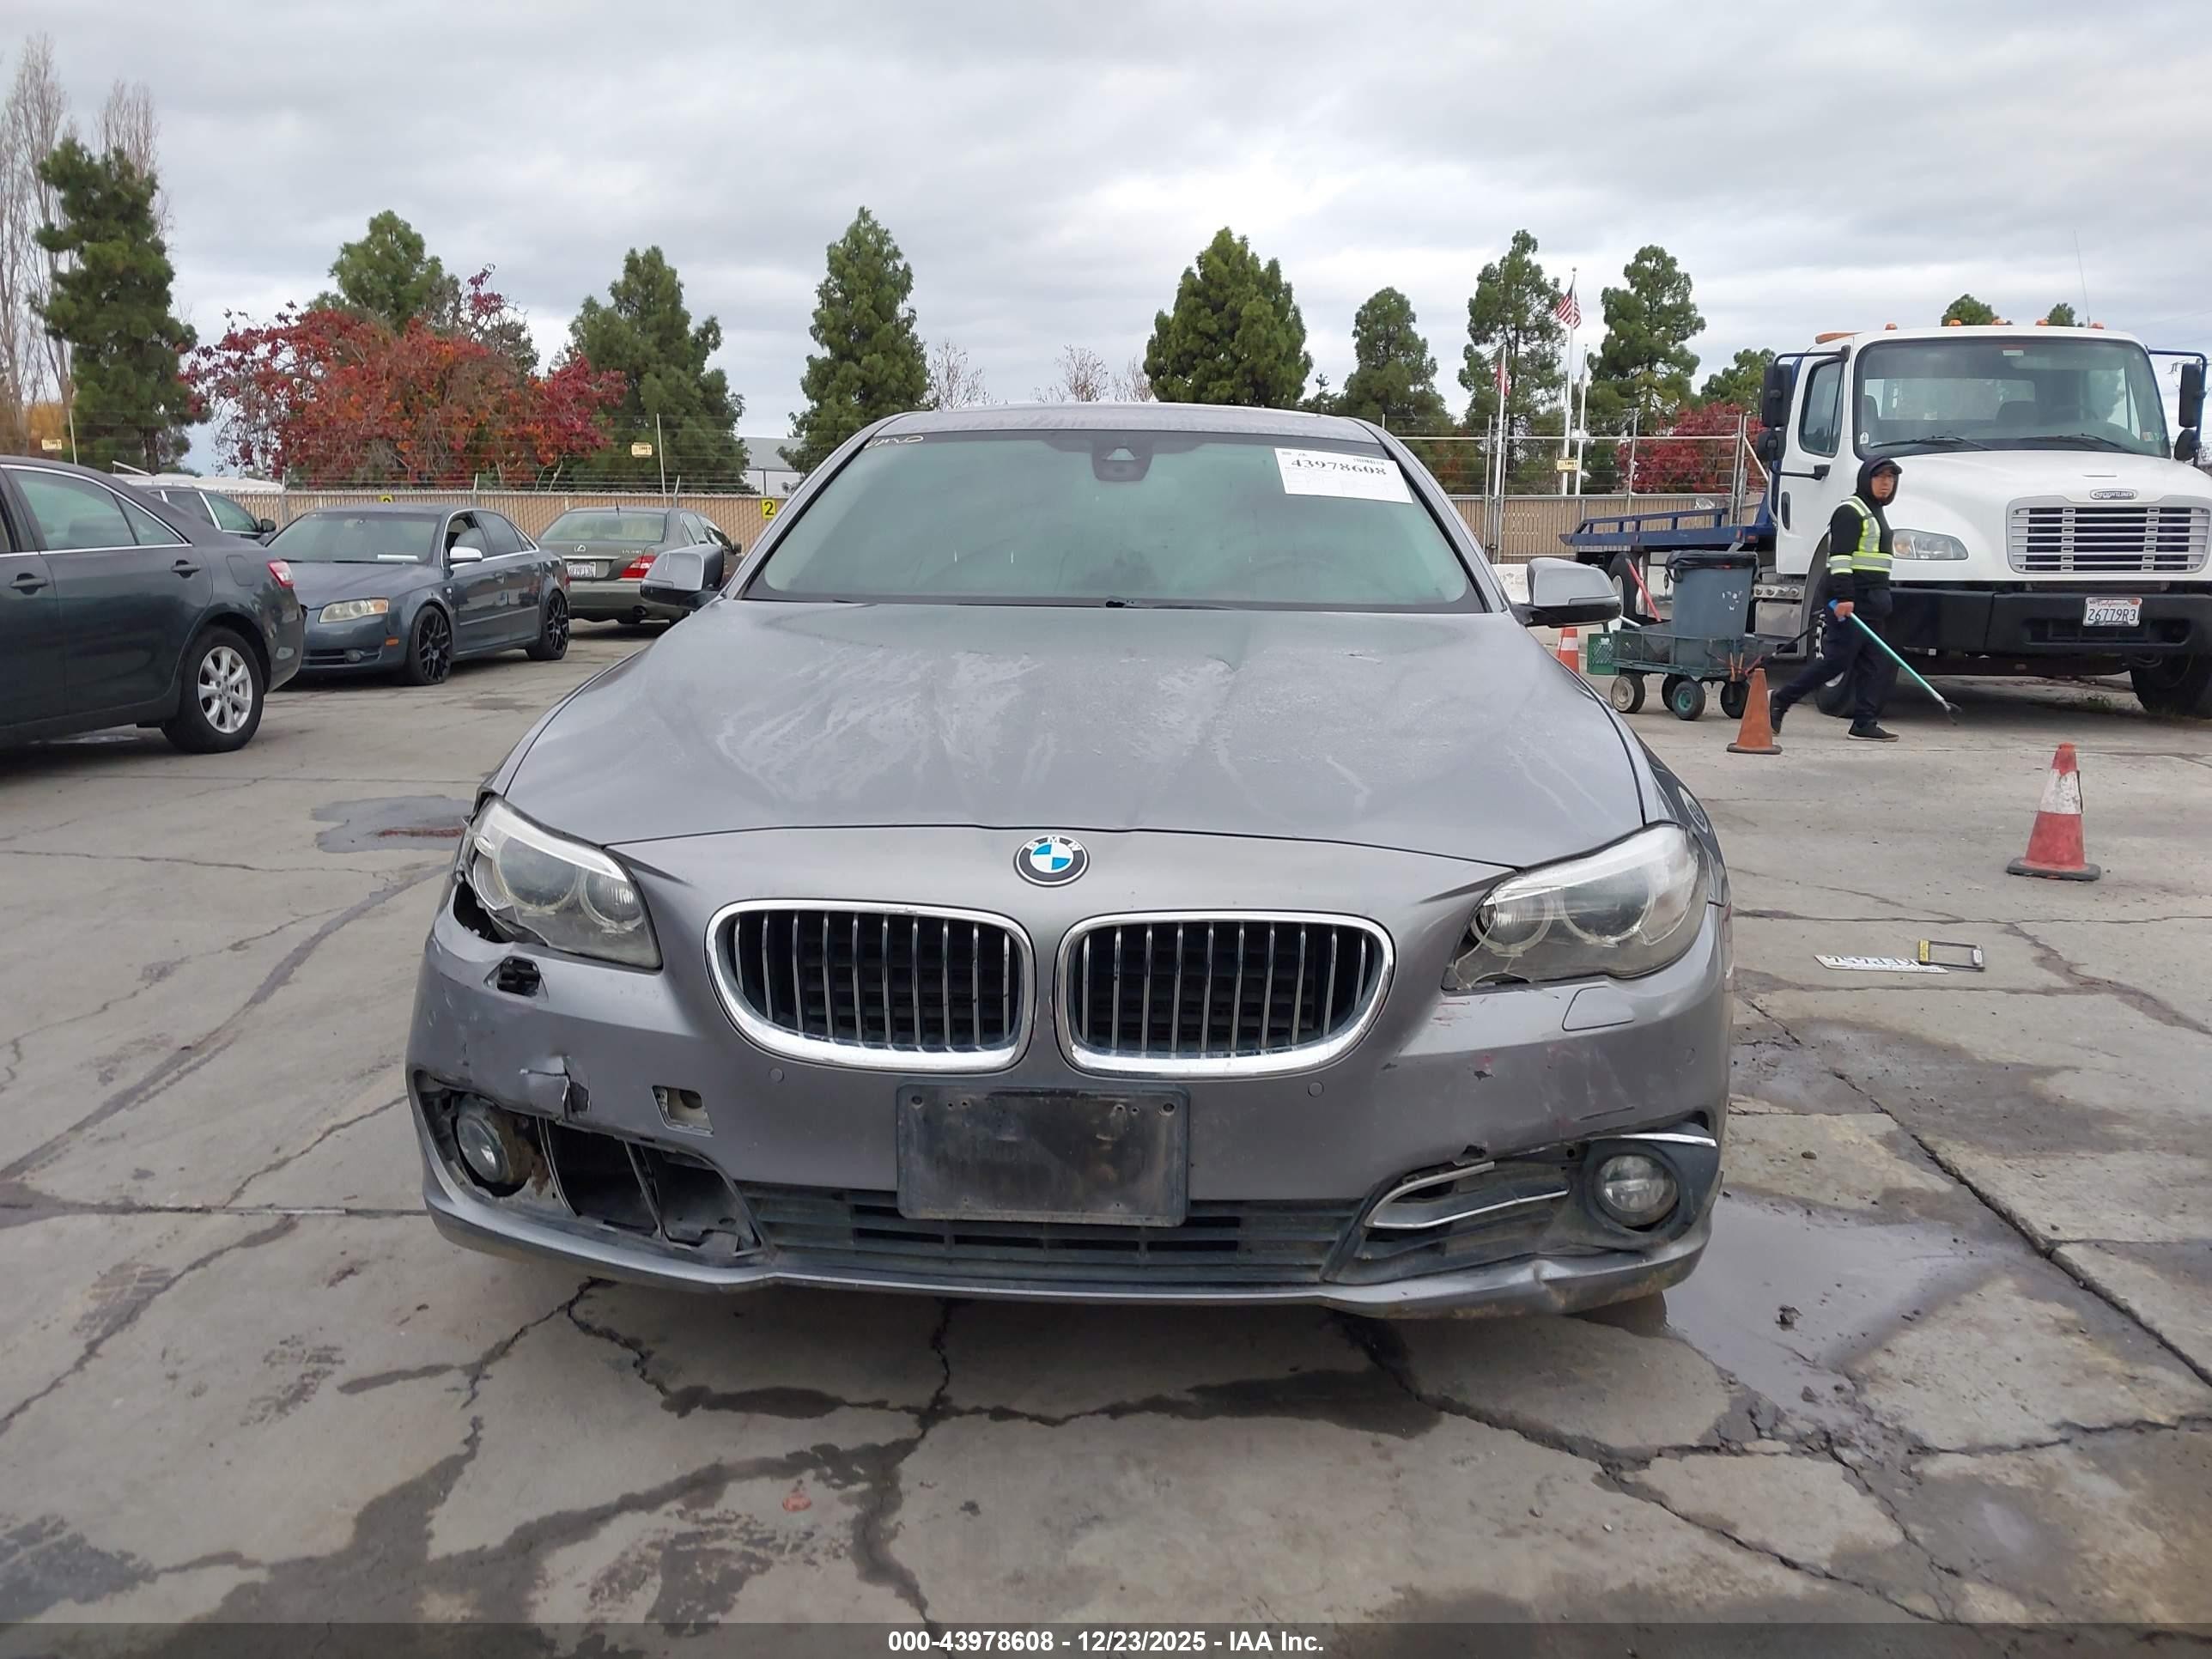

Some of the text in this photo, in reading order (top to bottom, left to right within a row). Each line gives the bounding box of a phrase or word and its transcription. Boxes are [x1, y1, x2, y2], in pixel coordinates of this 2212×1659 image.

[1291, 459, 1387, 475] 43978608
[764, 501, 775, 516] 2
[2087, 608, 2136, 622] 26779R3
[1025, 836, 1082, 851] BMW
